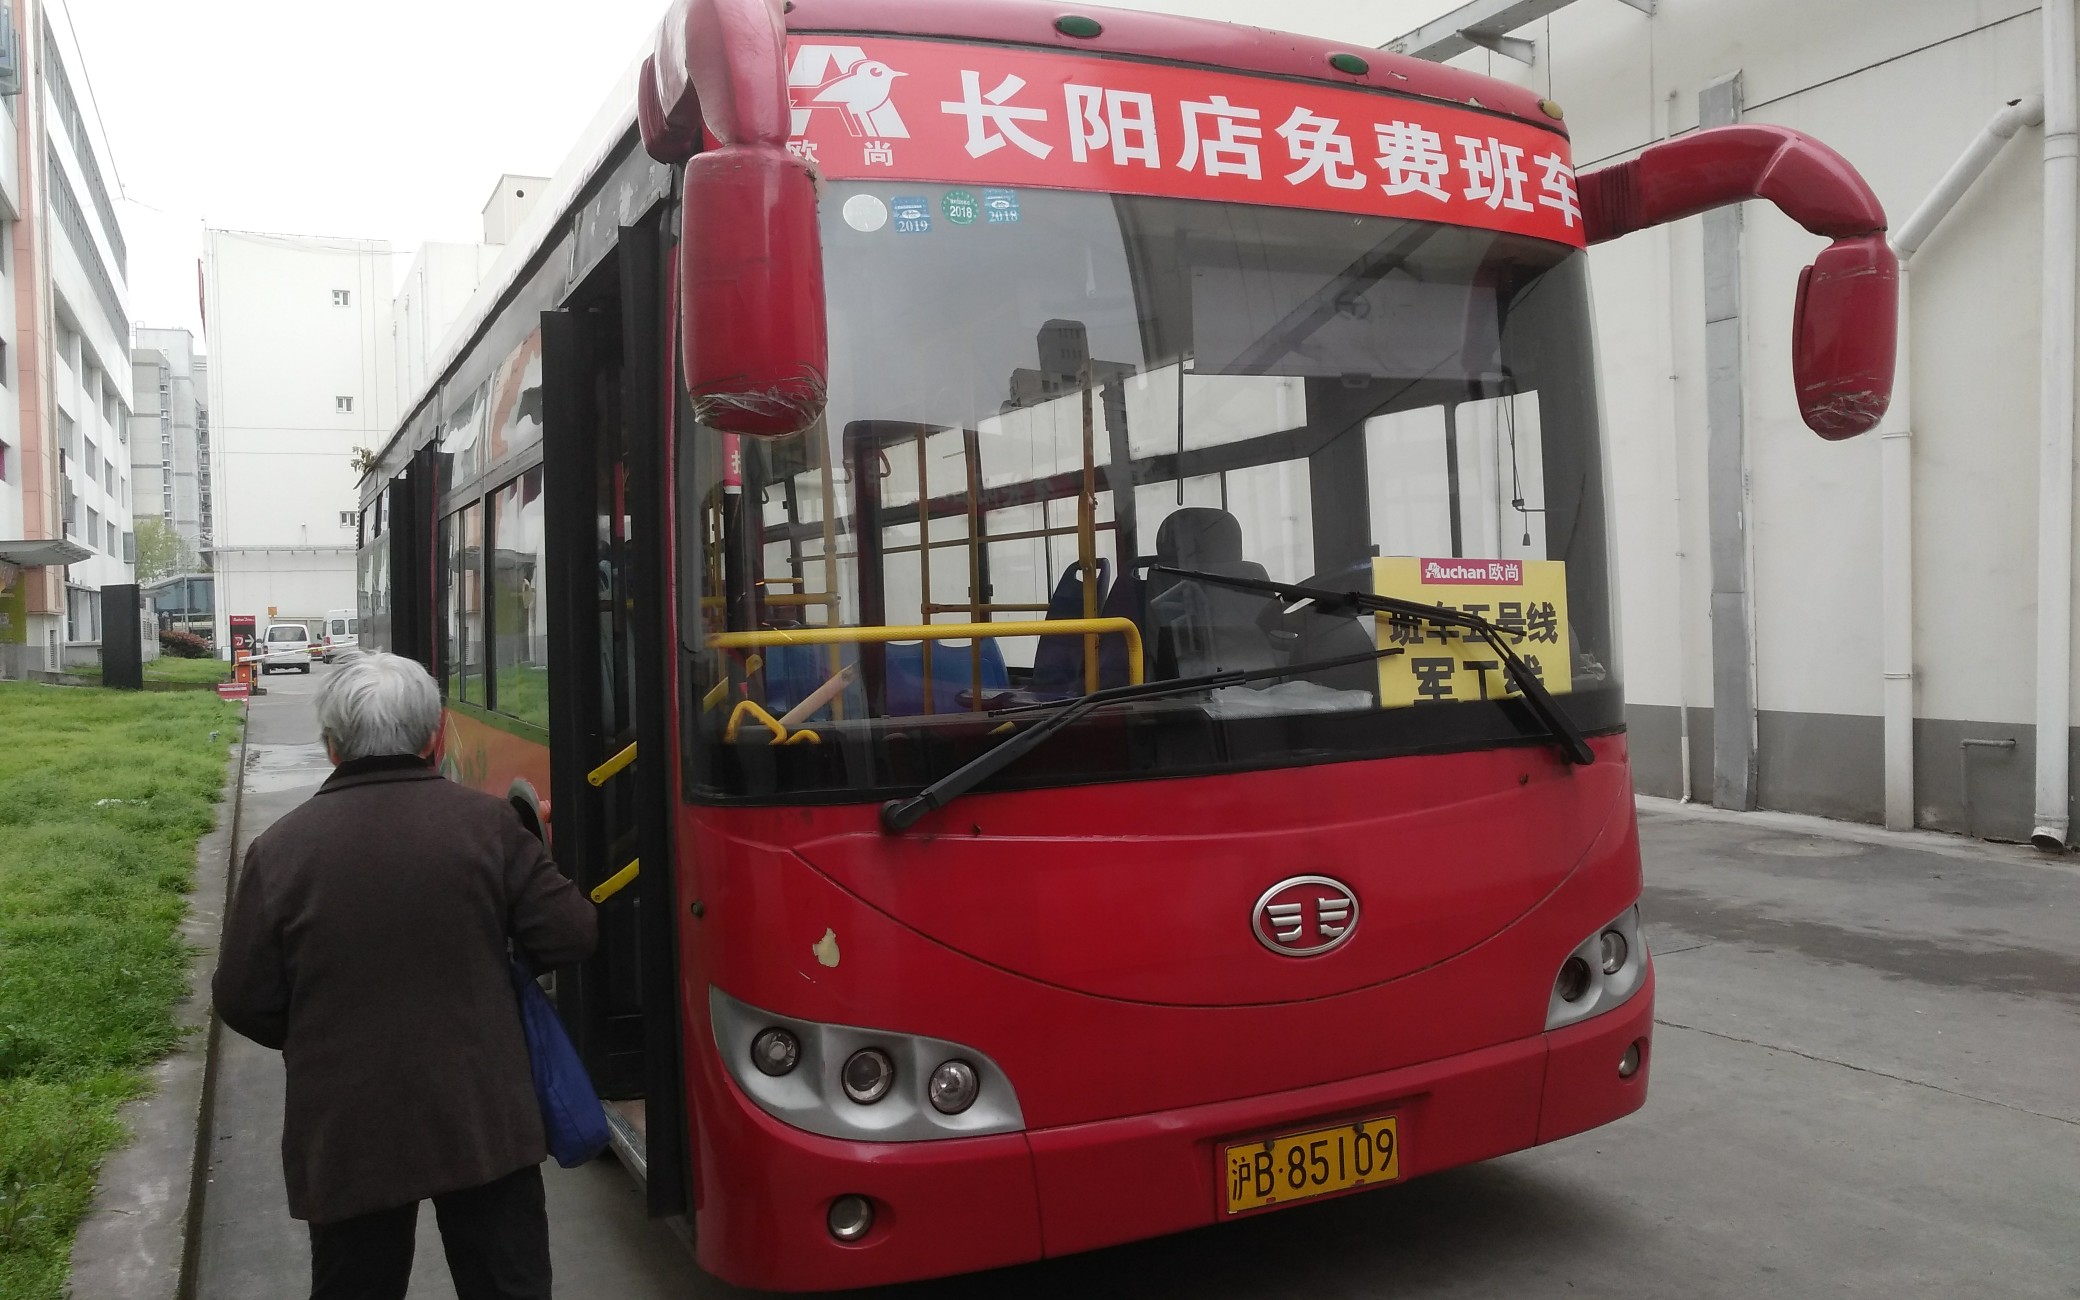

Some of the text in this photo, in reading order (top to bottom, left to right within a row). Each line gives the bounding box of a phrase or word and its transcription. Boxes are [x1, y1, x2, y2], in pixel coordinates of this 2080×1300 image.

[941, 70, 1583, 228] 长阳店免费班车
[949, 205, 973, 218] 2018
[988, 210, 1018, 223] 2018
[897, 220, 928, 232] 2019
[1425, 562, 1519, 581] Auchan 欧尚
